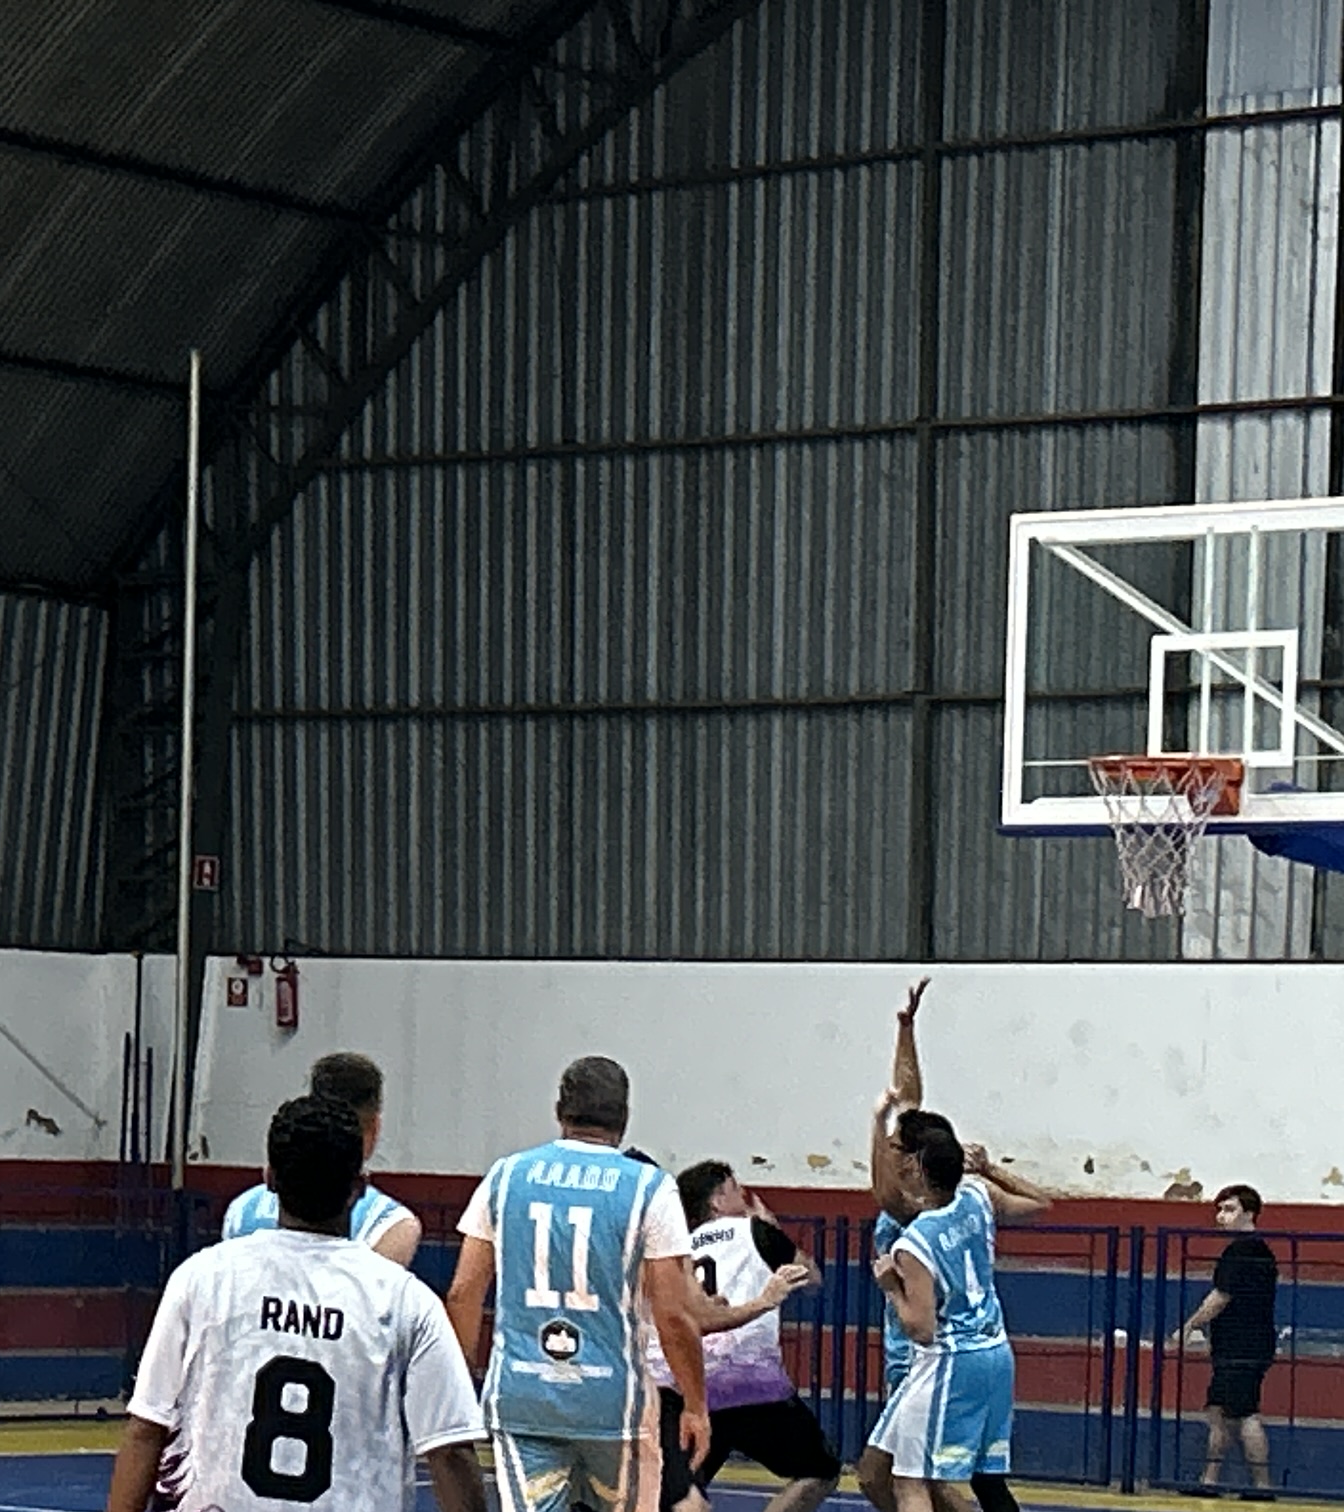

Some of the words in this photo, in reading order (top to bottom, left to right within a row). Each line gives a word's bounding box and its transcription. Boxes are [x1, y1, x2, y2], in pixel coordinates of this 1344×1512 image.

[524, 1202, 599, 1312] 11
[260, 1296, 344, 1341] RAND
[241, 1354, 335, 1503] 8
